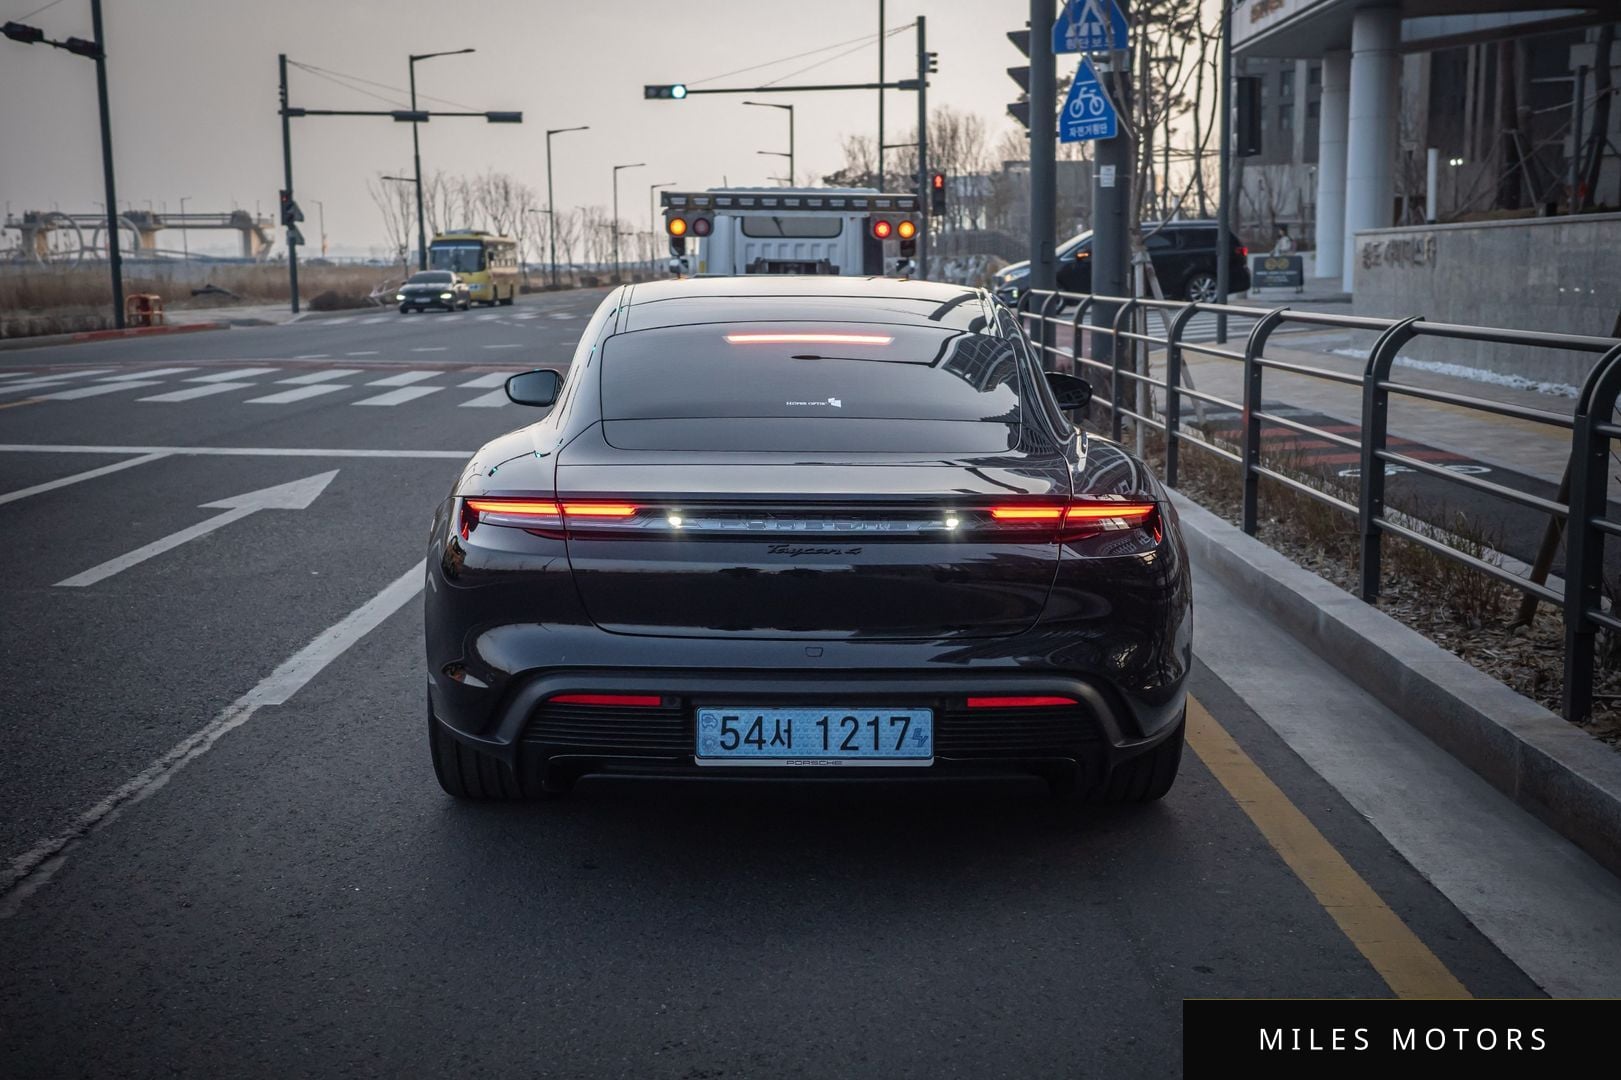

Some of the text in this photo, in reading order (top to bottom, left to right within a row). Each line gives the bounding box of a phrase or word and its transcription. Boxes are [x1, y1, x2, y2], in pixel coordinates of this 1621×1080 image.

[767, 544, 864, 557] Taycan 4
[720, 716, 911, 751] 54서 1217
